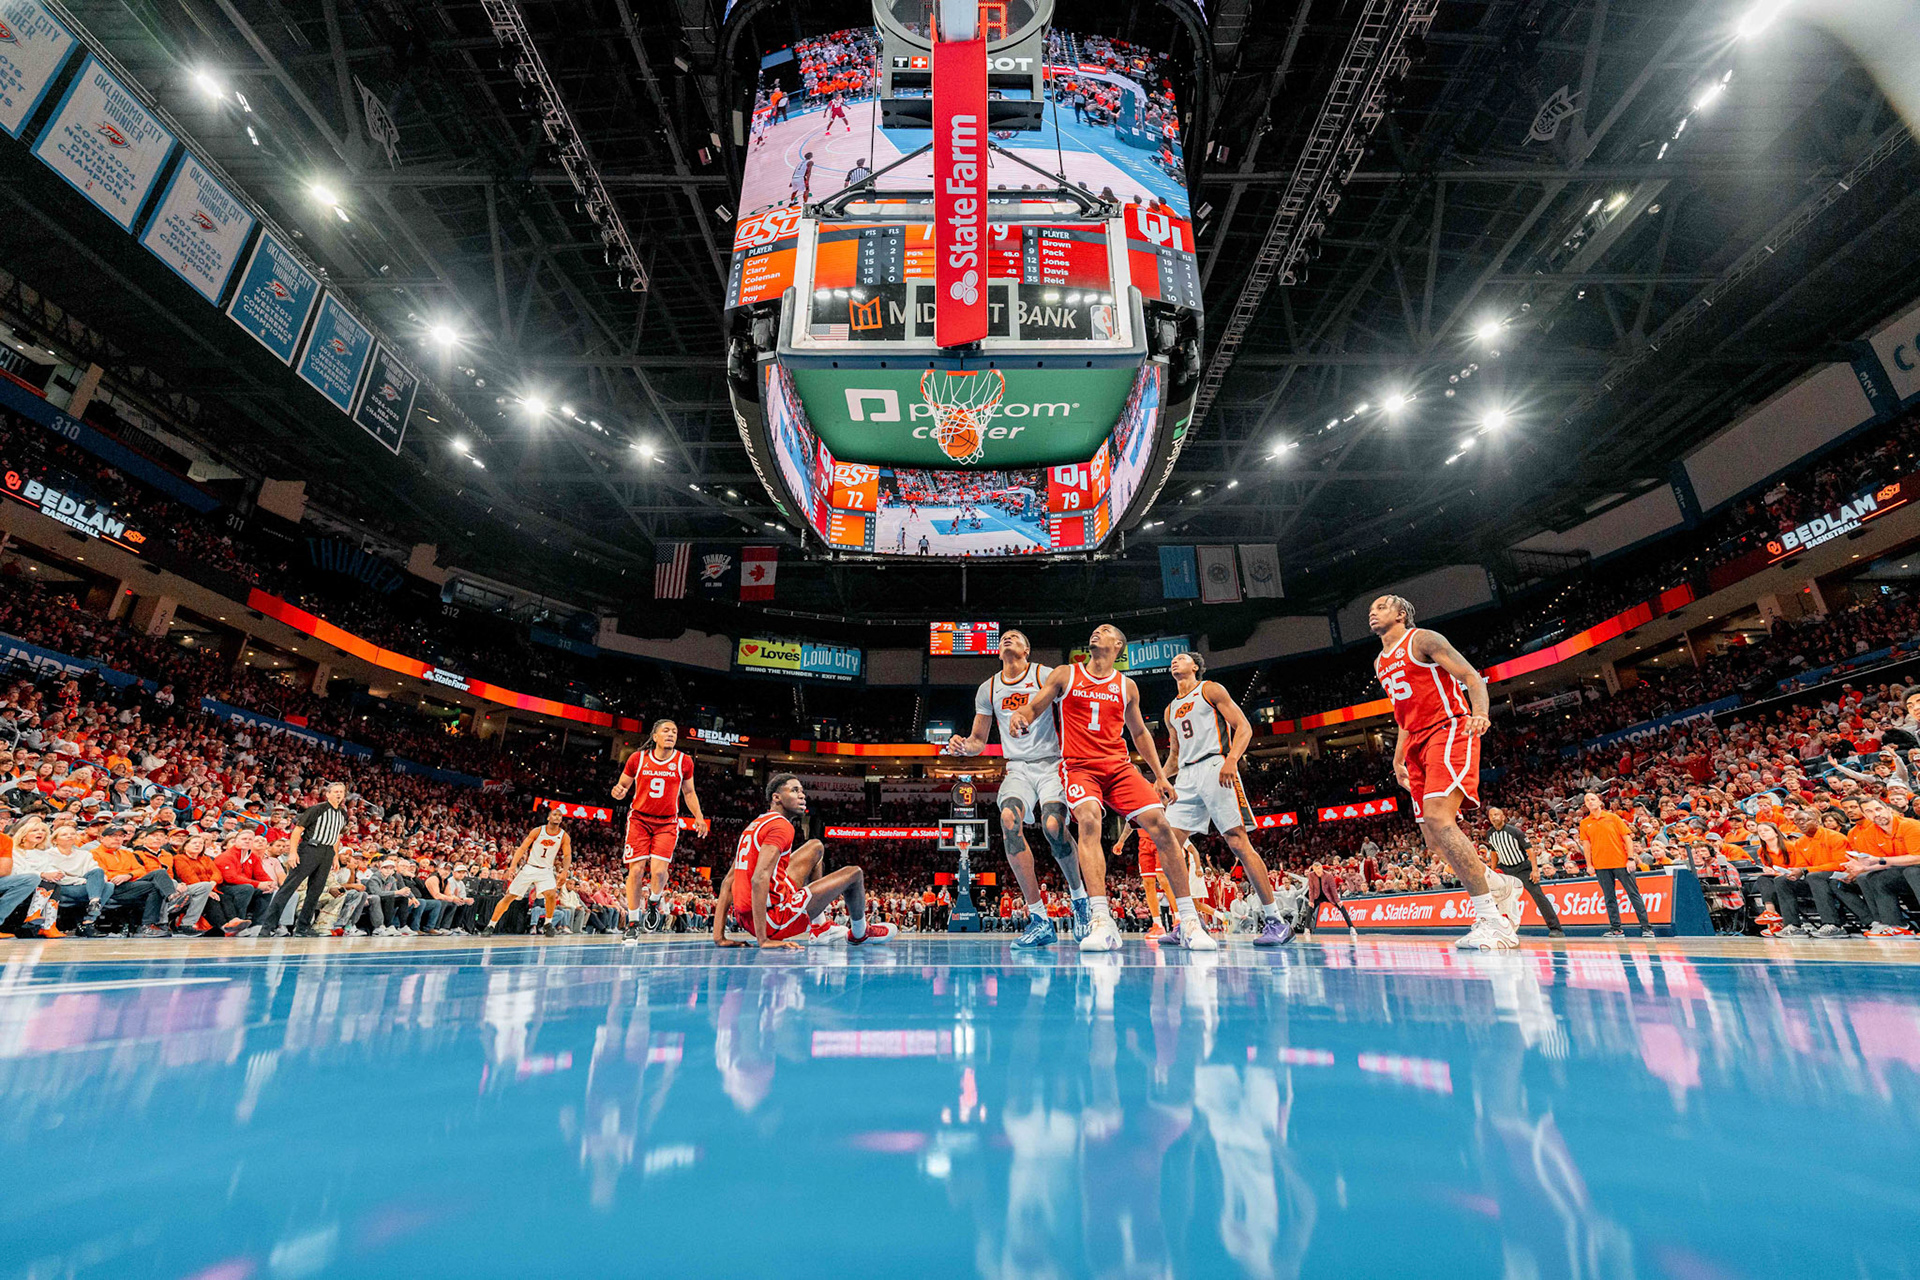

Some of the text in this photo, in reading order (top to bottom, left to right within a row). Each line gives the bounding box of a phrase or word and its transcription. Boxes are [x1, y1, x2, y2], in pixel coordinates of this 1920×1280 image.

[94, 73, 164, 144] OKLAHOMA CITY
[103, 99, 144, 144] THUNDER
[64, 126, 137, 191] NORTHWEST
[74, 123, 136, 181] 2023-2024
[58, 143, 127, 206] CHAMPIONS
[70, 144, 124, 191] DIVISION
[189, 166, 245, 225] OKLAHOMA CITY
[946, 114, 978, 268] StateFarm
[196, 189, 230, 227] THUNDER
[165, 218, 223, 271] NORTHWEST
[172, 214, 222, 260] 2024-2025
[1042, 230, 1070, 239] PLAYER
[1042, 240, 1072, 249] Brown
[160, 233, 215, 284] CHAMPIONS
[170, 232, 212, 272] DIVISION
[747, 257, 769, 267] Curry
[748, 244, 773, 257] PLAYER
[1042, 249, 1065, 257] Pack
[1043, 258, 1070, 266] Jones
[1161, 249, 1192, 262] PTS FLS
[266, 242, 313, 291] OKLAHOMA CITY
[271, 261, 301, 294] THUNDER
[745, 272, 780, 284] Coleman
[746, 266, 767, 275] Clary
[1043, 267, 1069, 276] Davis
[743, 283, 766, 294] Miller
[1043, 277, 1065, 285] Reid
[255, 286, 293, 323] 2011-2012
[742, 294, 758, 304] Roy
[1167, 294, 1177, 302] 10
[243, 295, 293, 341] CONFERENCE
[243, 303, 288, 345] CHAMPIONS
[253, 294, 290, 329] WESTERN
[328, 302, 367, 344] OKLAHOMA CITY
[888, 300, 1078, 329] MIDT BANK
[333, 321, 357, 347] THUNDER
[310, 354, 351, 391] CONFERENCE
[310, 362, 348, 396] CHAMPIONS
[318, 352, 349, 381] WESTERN
[51, 415, 81, 441] 310
[365, 405, 398, 435] CHAMPIONS
[912, 425, 1025, 440] ceer
[23, 479, 125, 539] BEDLAM
[847, 490, 864, 508] 72
[1061, 491, 1080, 509] 79
[41, 506, 100, 538] BASKETBALL
[226, 513, 245, 532] 311
[1781, 494, 1877, 550] BEDLAM
[1806, 519, 1862, 550] BASKETBALL
[441, 604, 460, 619] 312
[803, 650, 858, 672] LOUD CITY
[1131, 645, 1160, 666] LOUD
[434, 673, 470, 691] StateFarm
[782, 670, 813, 678] THUNDER
[1072, 689, 1120, 703] OKLAHOMA
[1087, 702, 1101, 731] 1
[1182, 719, 1194, 740] 9
[697, 728, 739, 743] BEDLAM
[642, 769, 676, 778] OKLAHOMA
[649, 778, 665, 798] 9
[837, 829, 867, 837] StateFarm
[877, 829, 908, 837] StateFarm
[540, 848, 547, 858] 1
[734, 834, 752, 870] 12
[1384, 903, 1434, 921] StateFarm
